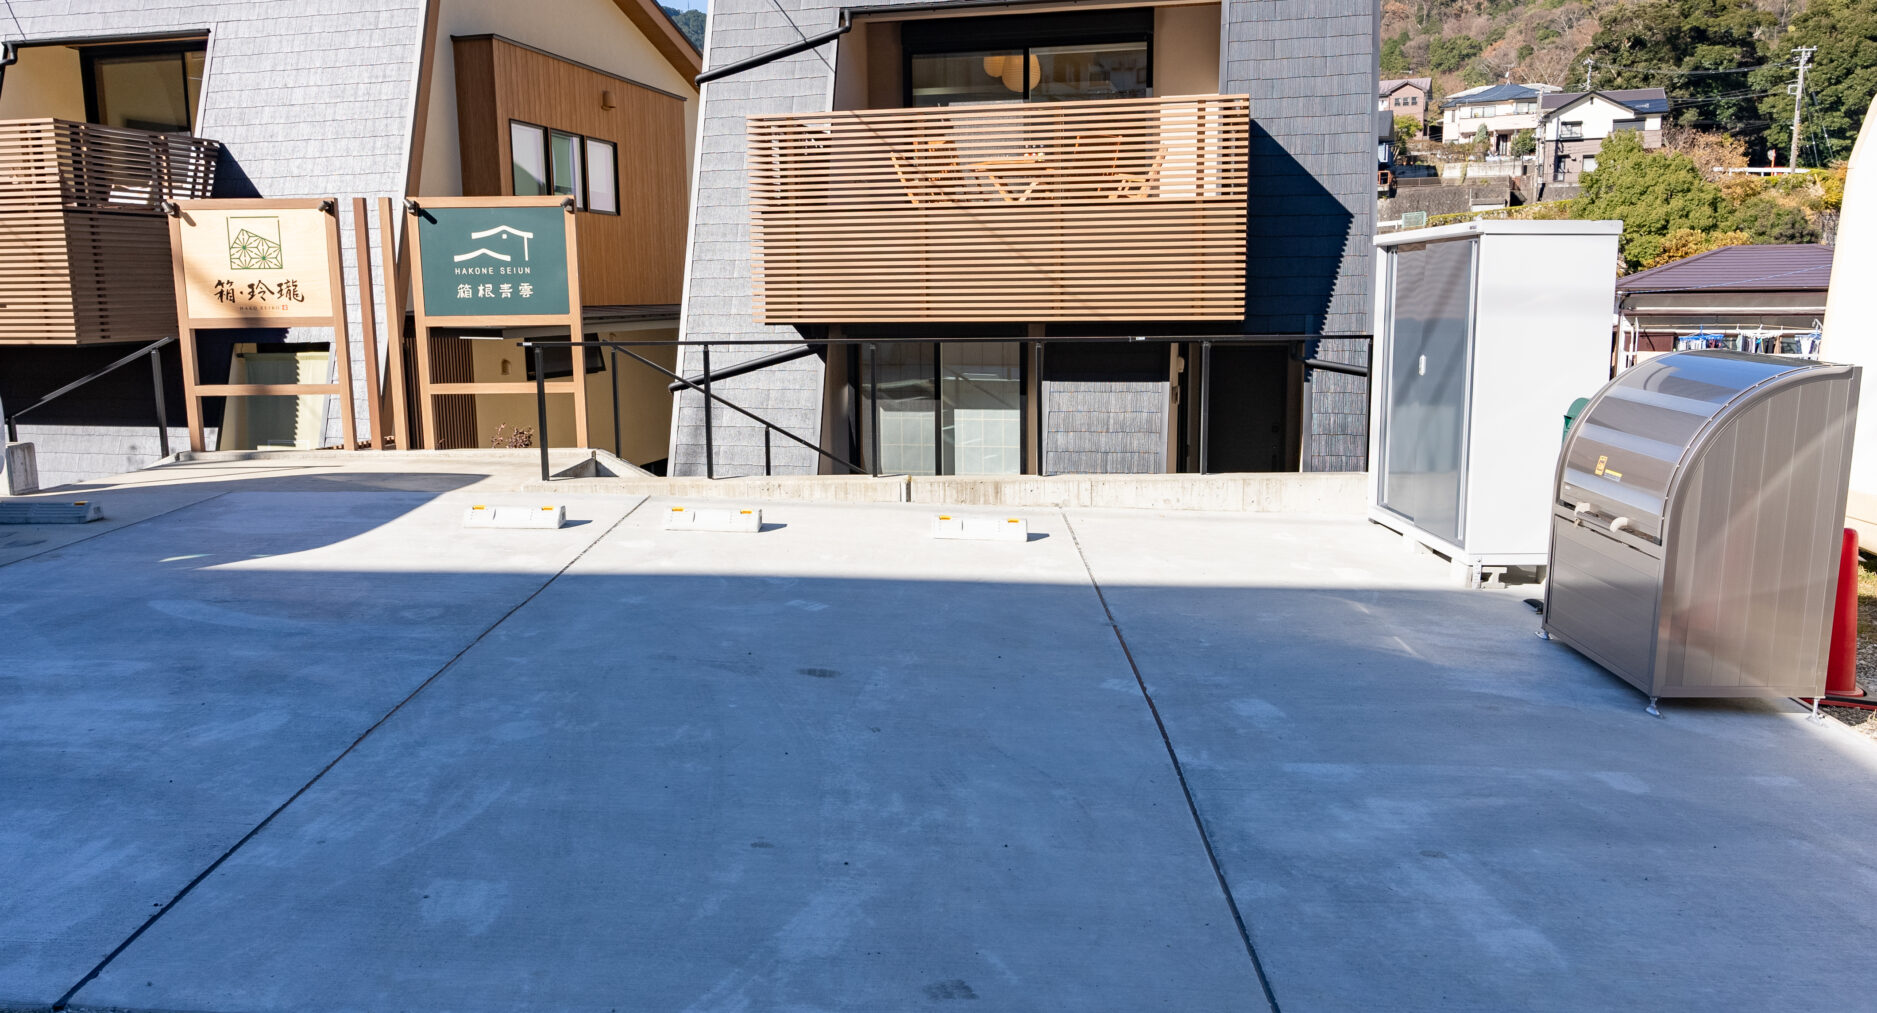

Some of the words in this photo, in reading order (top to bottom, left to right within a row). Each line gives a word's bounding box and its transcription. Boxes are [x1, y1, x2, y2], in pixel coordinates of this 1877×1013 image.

[455, 267, 495, 275] HAKONE
[500, 266, 531, 275] SEIUN
[457, 283, 534, 298] 箱根青雲
